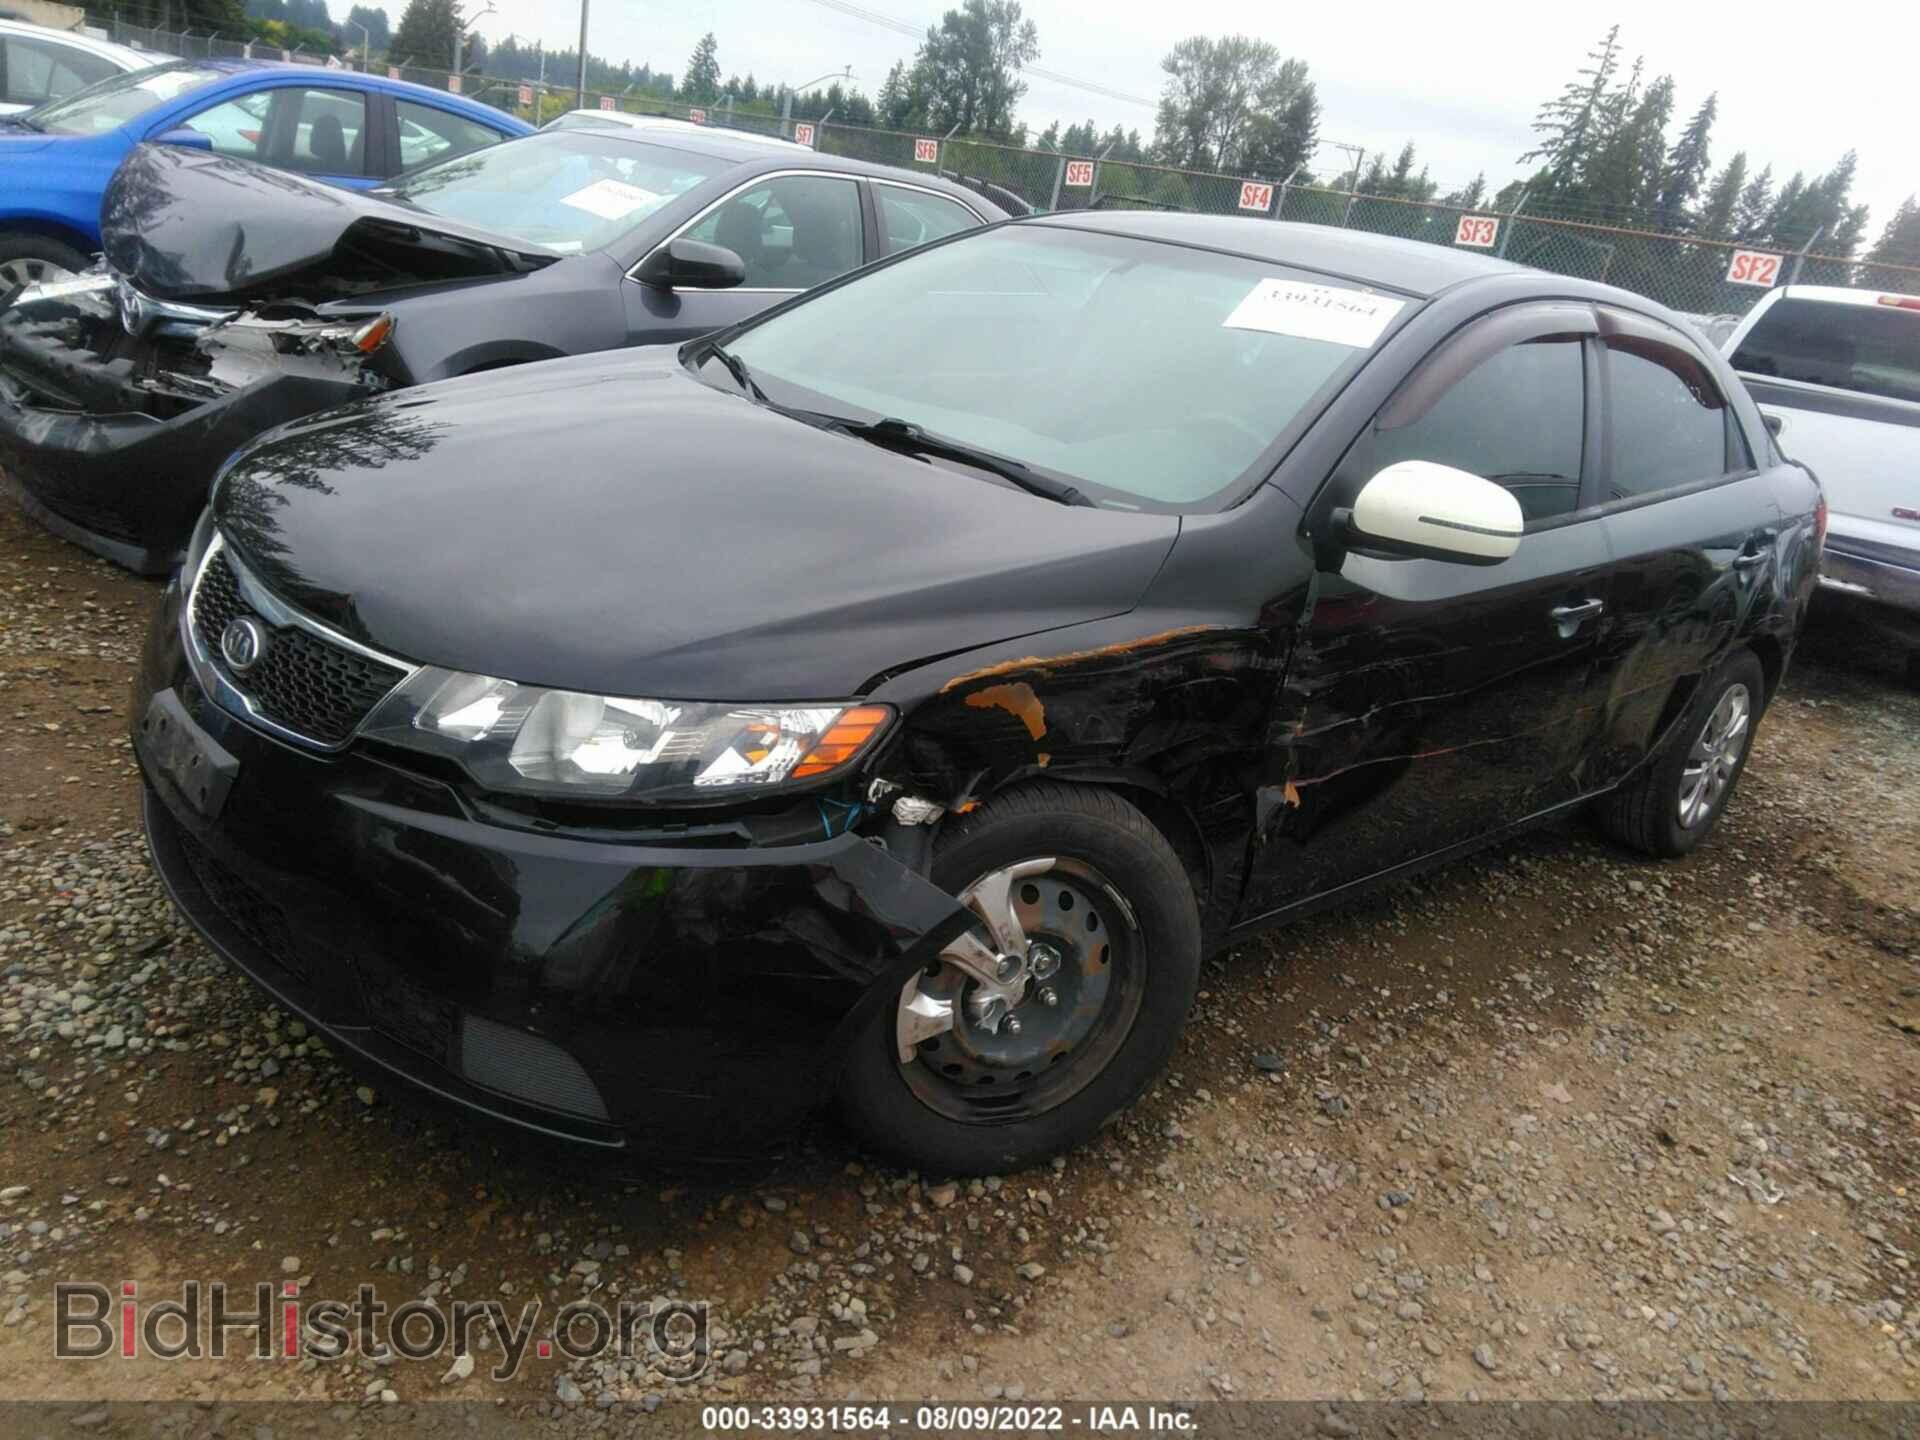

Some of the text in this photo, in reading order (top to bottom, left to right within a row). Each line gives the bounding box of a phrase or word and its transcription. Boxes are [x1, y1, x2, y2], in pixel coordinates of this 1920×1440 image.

[916, 141, 936, 161] SF6
[1068, 163, 1092, 183] SF5
[1242, 184, 1270, 209] SF4
[1460, 219, 1495, 244] SF3
[1732, 255, 1777, 284] SF2
